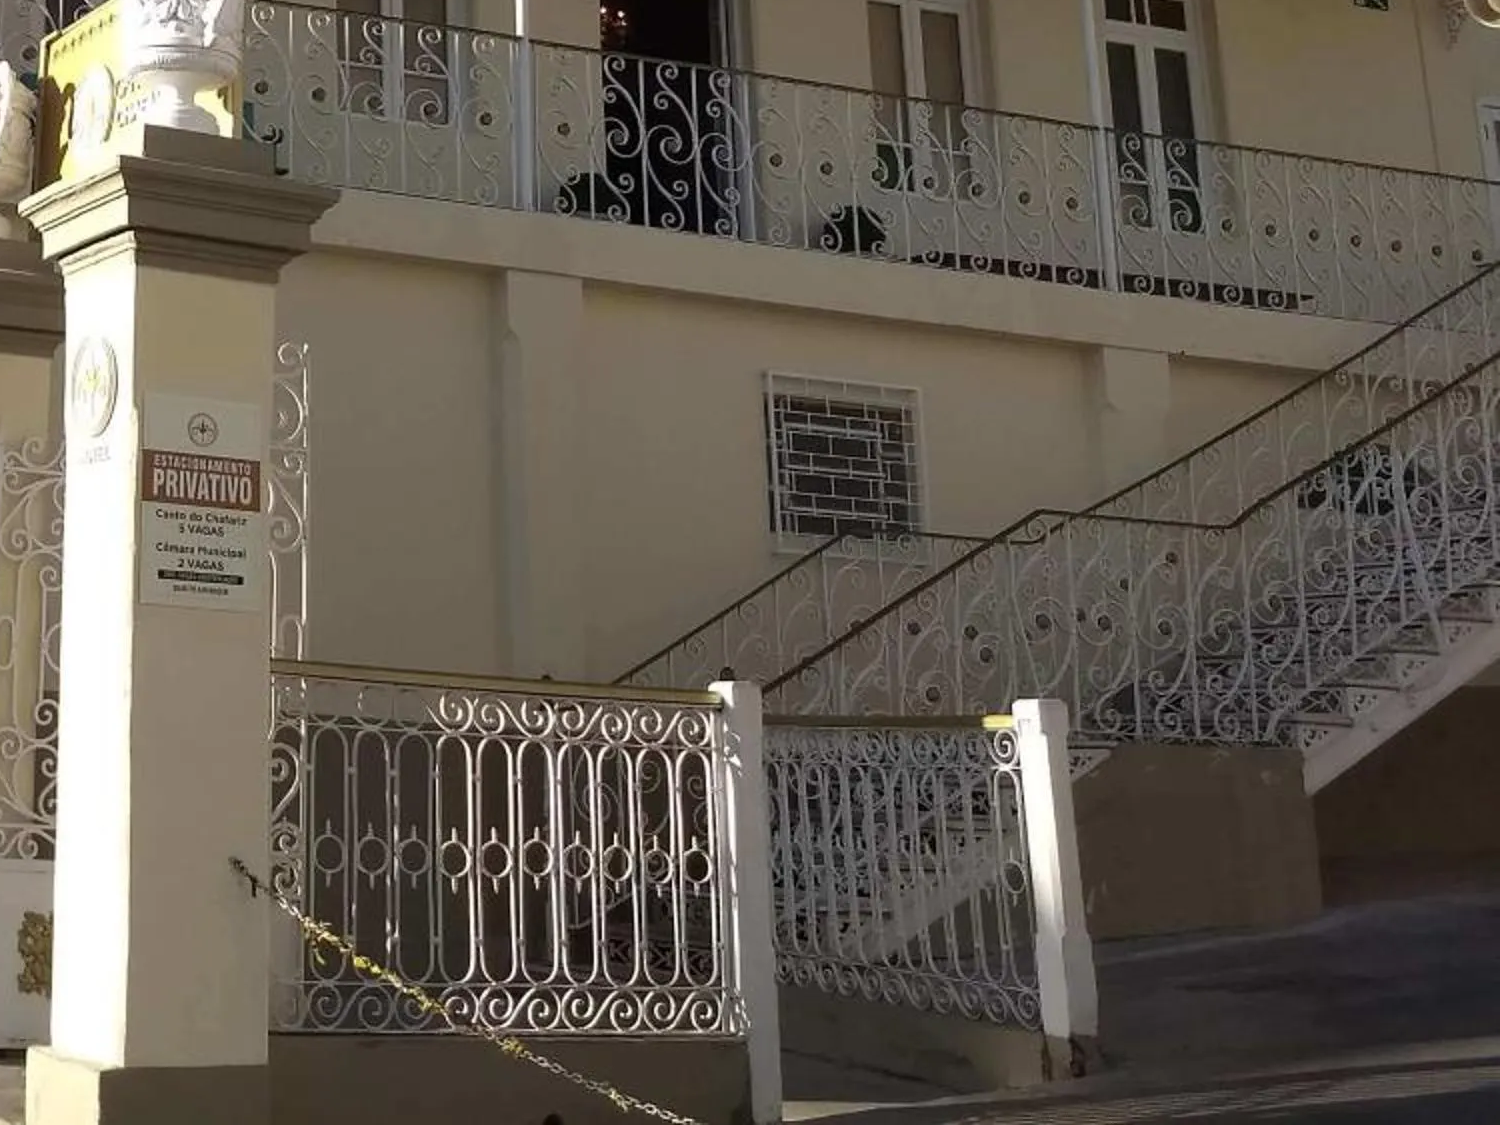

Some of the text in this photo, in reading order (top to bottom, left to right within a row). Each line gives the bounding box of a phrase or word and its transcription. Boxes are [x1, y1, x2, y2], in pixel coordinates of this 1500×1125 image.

[153, 453, 251, 476] ESTACIONAMENTO
[152, 468, 252, 506] PRIVATIVO
[187, 523, 226, 537] VAGAS
[187, 559, 226, 572] VAGAS
